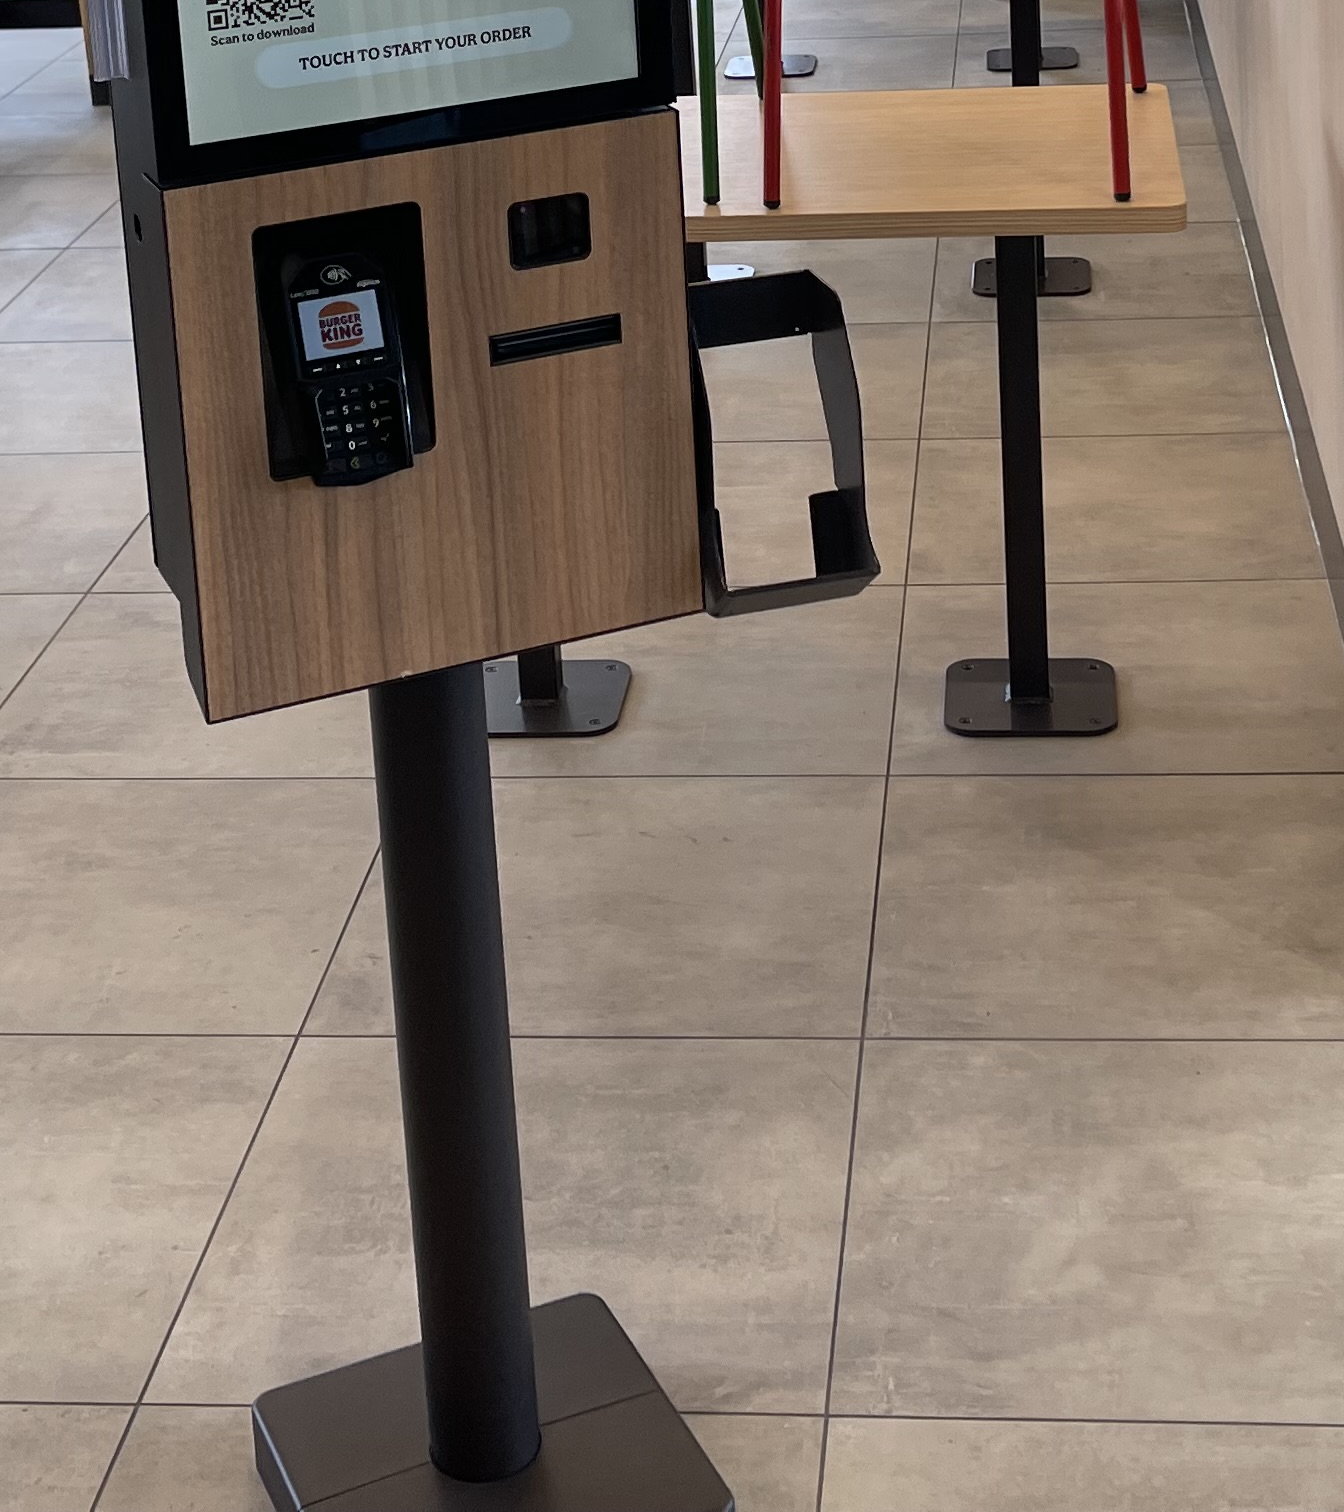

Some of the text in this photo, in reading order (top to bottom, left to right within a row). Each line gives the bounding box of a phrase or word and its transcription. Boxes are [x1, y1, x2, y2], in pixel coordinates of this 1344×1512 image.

[210, 22, 315, 47] Scan to download
[298, 25, 532, 71] TOUCH TO START YOUR ORDER
[318, 313, 362, 328] BURGER
[320, 323, 364, 342] KING
